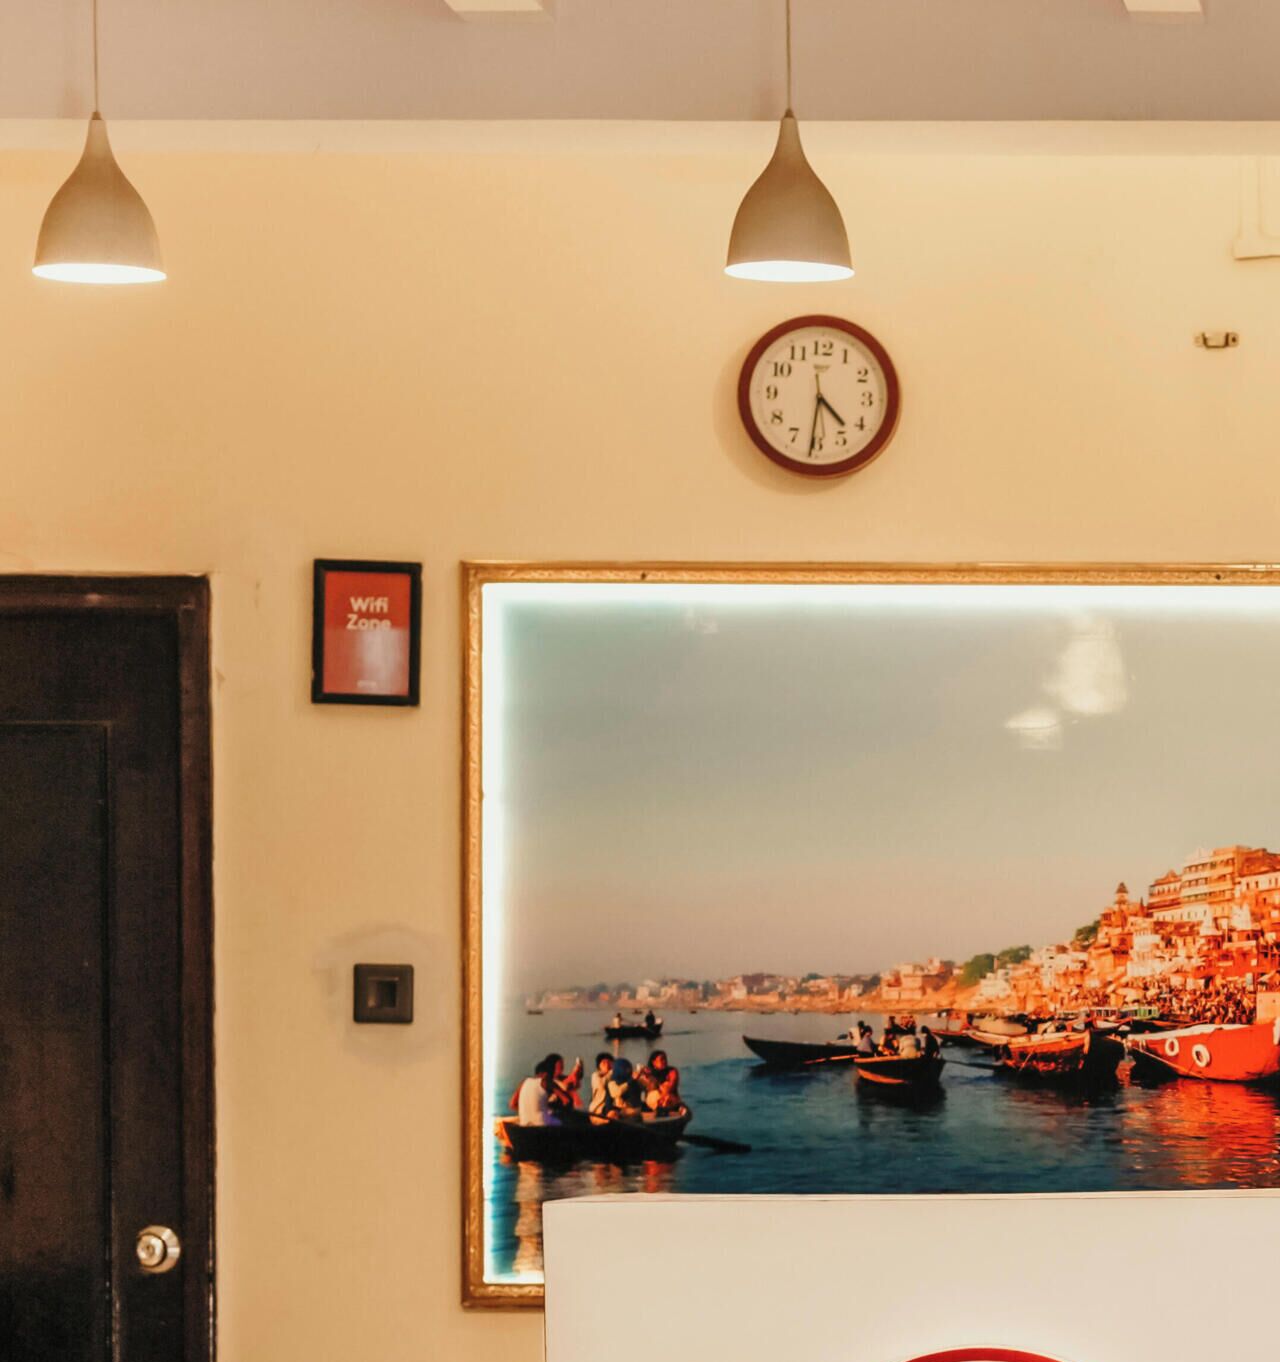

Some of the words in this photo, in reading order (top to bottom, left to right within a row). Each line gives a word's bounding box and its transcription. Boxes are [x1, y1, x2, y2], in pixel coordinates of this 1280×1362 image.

[790, 345, 806, 361] 11
[813, 340, 833, 356] 12
[842, 349, 848, 364] 1
[772, 362, 792, 377] 10
[857, 368, 869, 383] 2
[766, 385, 779, 400] 9
[861, 392, 873, 407] 3
[771, 410, 784, 425] 8
[854, 416, 866, 431] 4
[788, 427, 799, 443] 7
[835, 431, 847, 447] 5
[350, 597, 388, 613] Wifi
[346, 613, 392, 631] Zone
